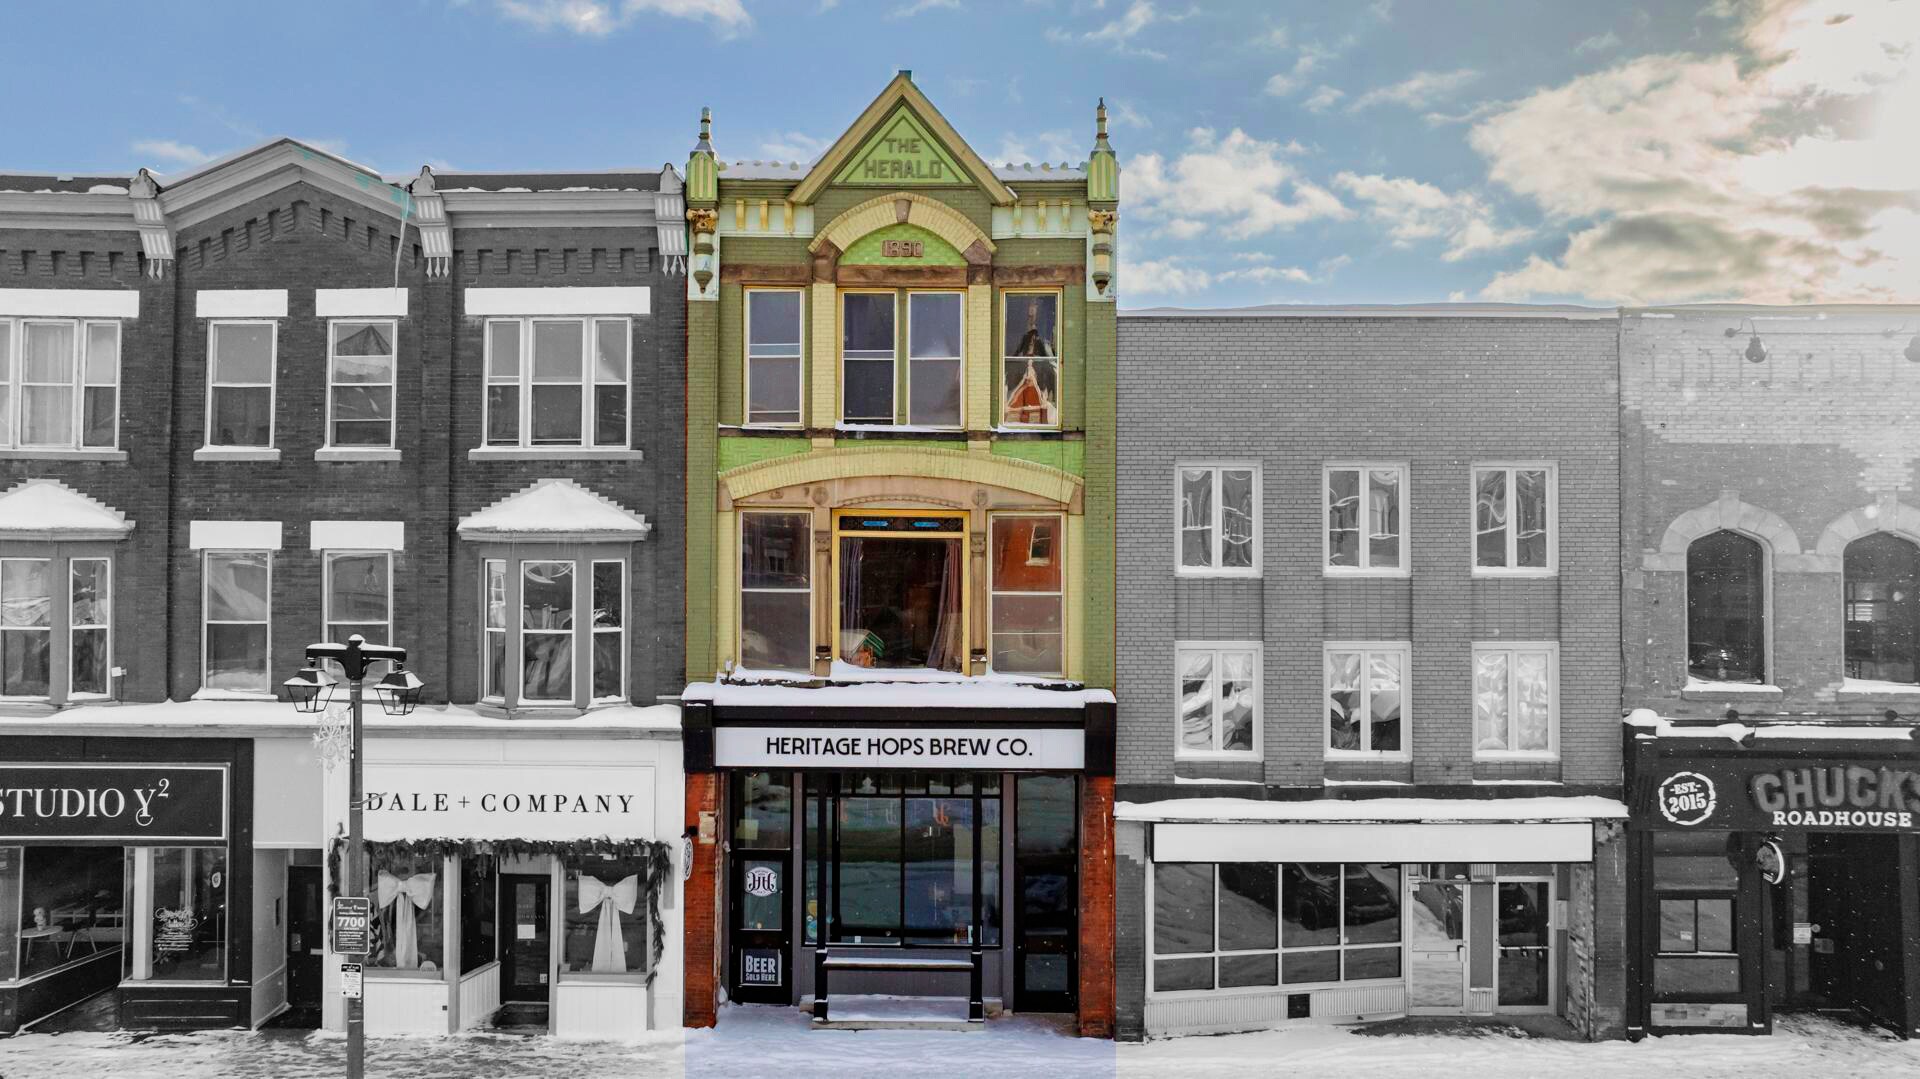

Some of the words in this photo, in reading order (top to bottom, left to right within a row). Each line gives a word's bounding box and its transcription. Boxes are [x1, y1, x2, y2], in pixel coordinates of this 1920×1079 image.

[885, 138, 922, 154] THE
[864, 160, 942, 179] HERALD
[882, 239, 924, 257] 1890
[766, 737, 862, 756] HERITAGE
[867, 738, 924, 756] HOPS
[930, 738, 991, 756] BREW
[996, 738, 1033, 756] CO.
[365, 793, 449, 812] DALE
[457, 796, 471, 809] +
[481, 794, 634, 813] COMPANY
[1668, 793, 1706, 814] 2015
[1772, 811, 1912, 828] ROADHOUSE
[337, 916, 365, 928] 7700
[745, 955, 776, 973] BEER
